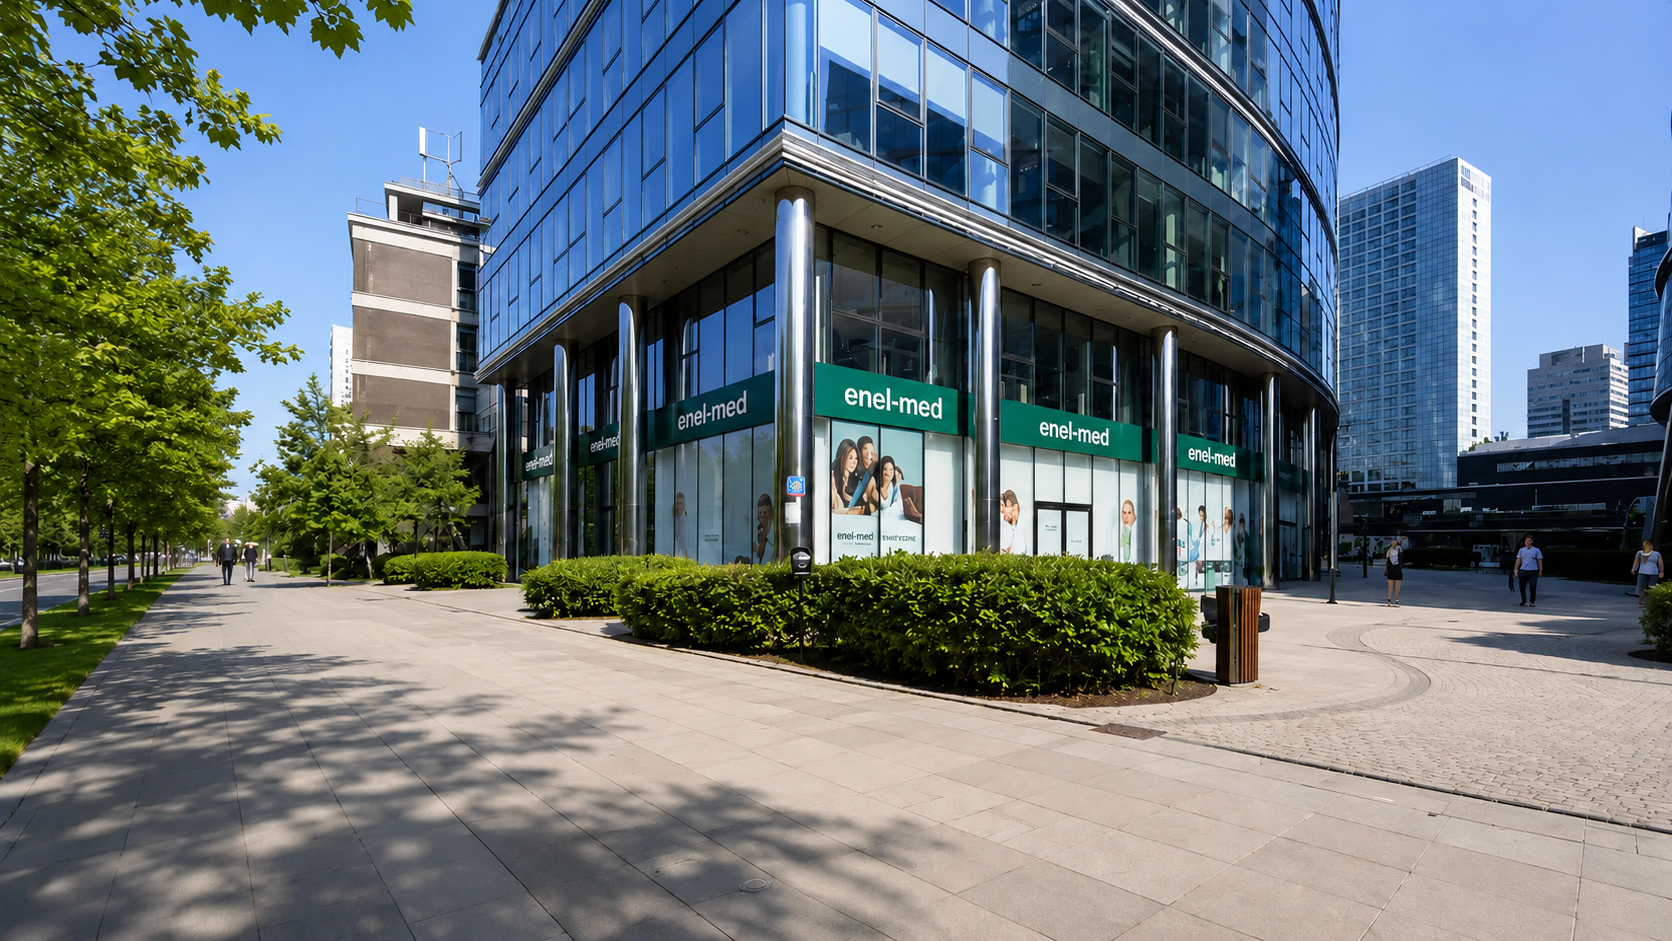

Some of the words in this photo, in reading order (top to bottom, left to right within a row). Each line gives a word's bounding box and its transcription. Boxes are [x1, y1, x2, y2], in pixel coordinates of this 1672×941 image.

[677, 390, 747, 430] enel-med
[844, 387, 943, 420] enel-med
[1039, 421, 1110, 447] enel-med
[525, 449, 554, 472] enel-med
[1188, 446, 1236, 468] enel-med
[836, 531, 874, 541] enel-med
